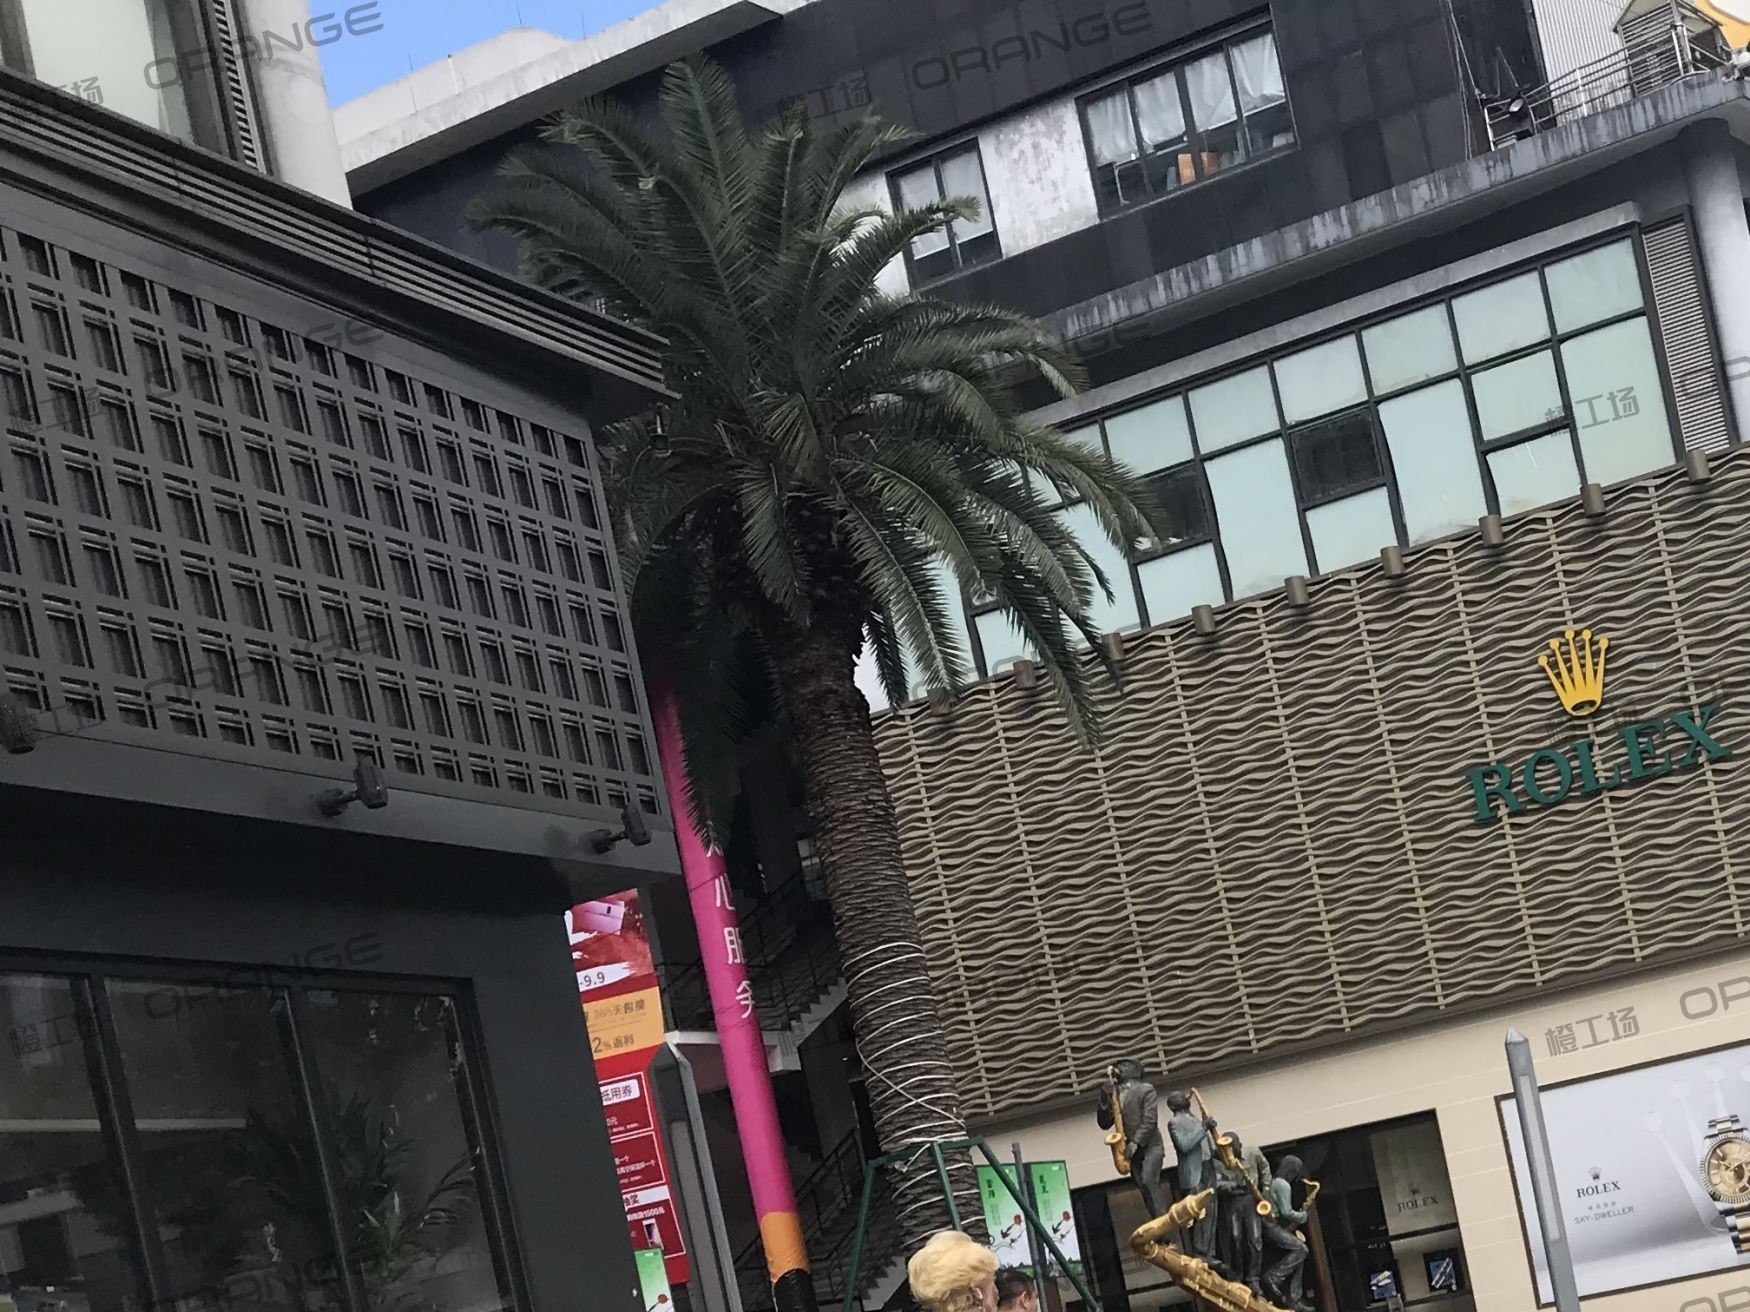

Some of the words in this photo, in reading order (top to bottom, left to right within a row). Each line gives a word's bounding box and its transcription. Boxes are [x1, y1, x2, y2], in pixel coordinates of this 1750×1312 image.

[1464, 703, 1733, 823] ROLEX
[1576, 1180, 1621, 1199] ROLEX
[1396, 1196, 1439, 1213] ROLEX
